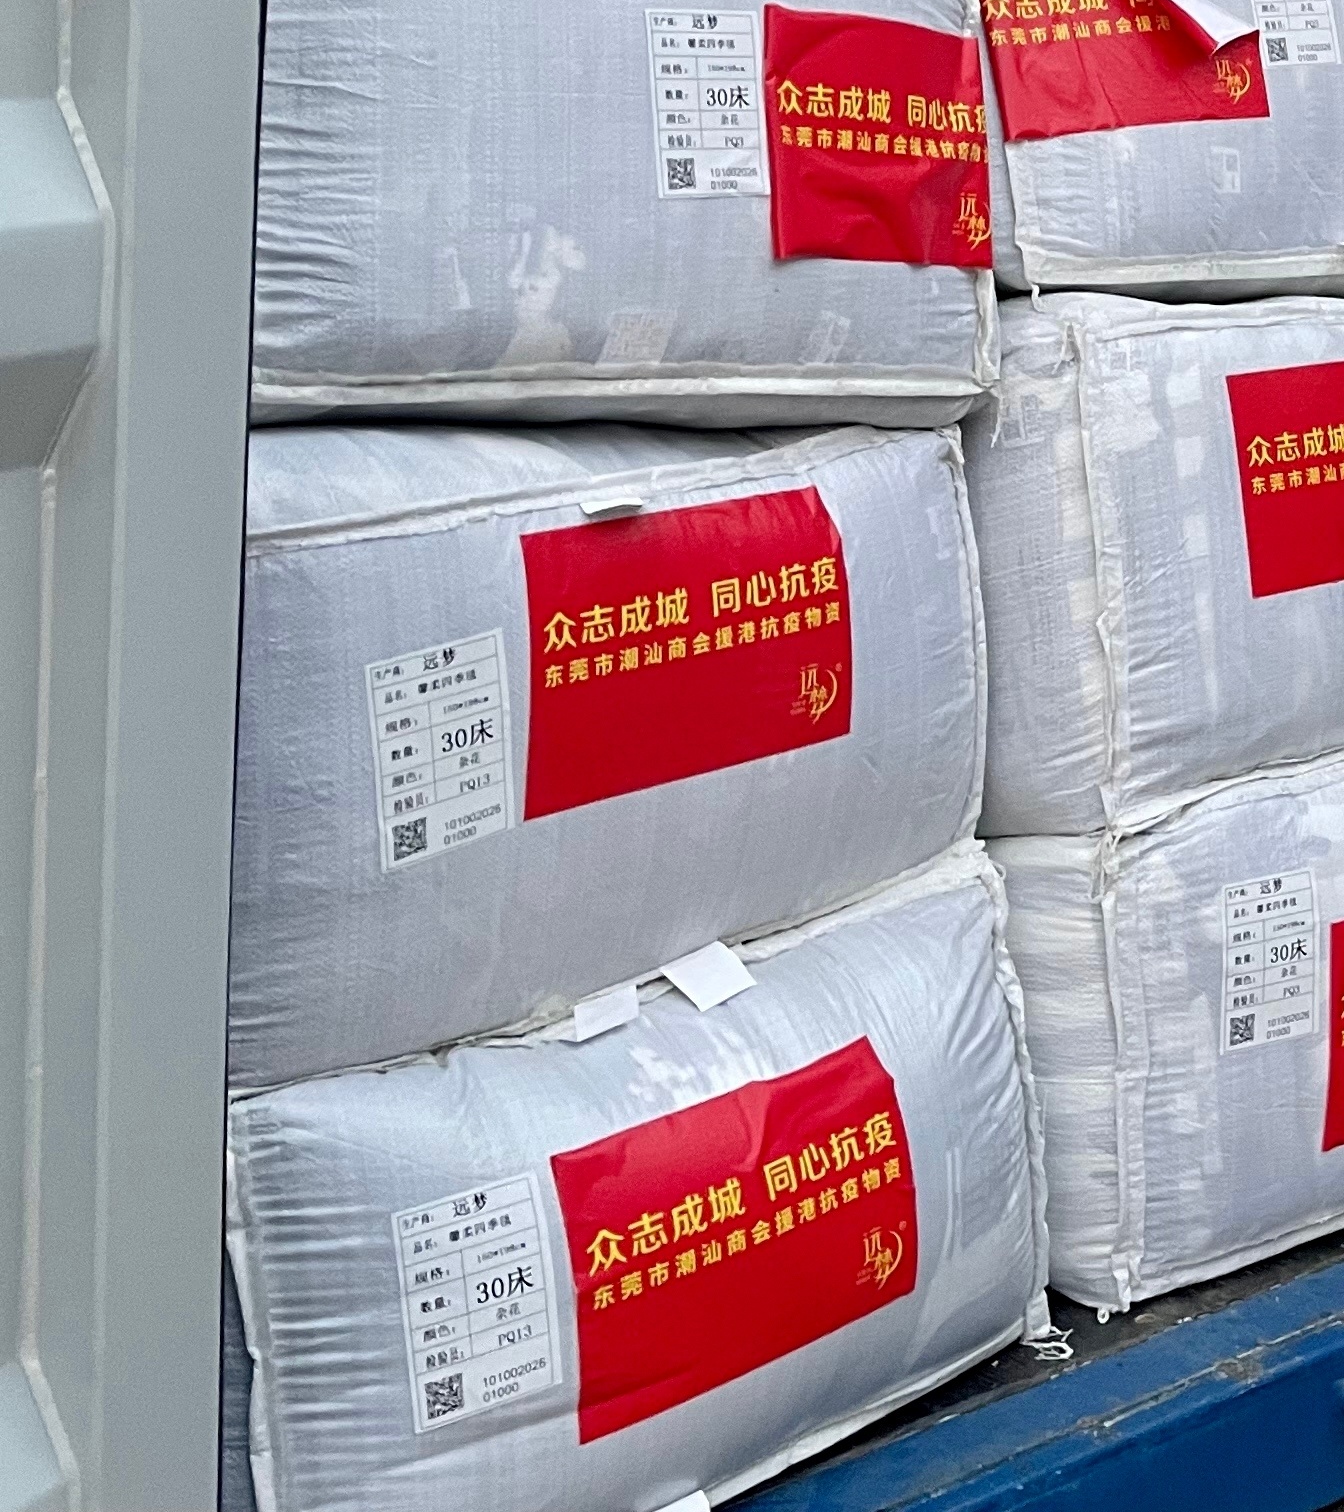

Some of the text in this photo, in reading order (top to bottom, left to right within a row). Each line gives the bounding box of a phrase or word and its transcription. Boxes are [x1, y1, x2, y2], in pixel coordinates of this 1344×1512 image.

[706, 86, 749, 108] 30床
[776, 79, 891, 124] 众志成城
[542, 557, 839, 654] 众志成城 同心抗疫
[544, 602, 842, 688] 东莞市潮汕商会援港抗疫物资
[441, 718, 494, 753] 30床
[1270, 938, 1307, 964] 30床
[452, 1191, 488, 1218] 远梦
[585, 1111, 897, 1277] 众志成城 同心抗疫
[593, 1157, 901, 1310] 东莞市潮汕商会援港抗疫物资
[476, 1266, 534, 1304] 30床
[482, 1381, 519, 1403] 01000
